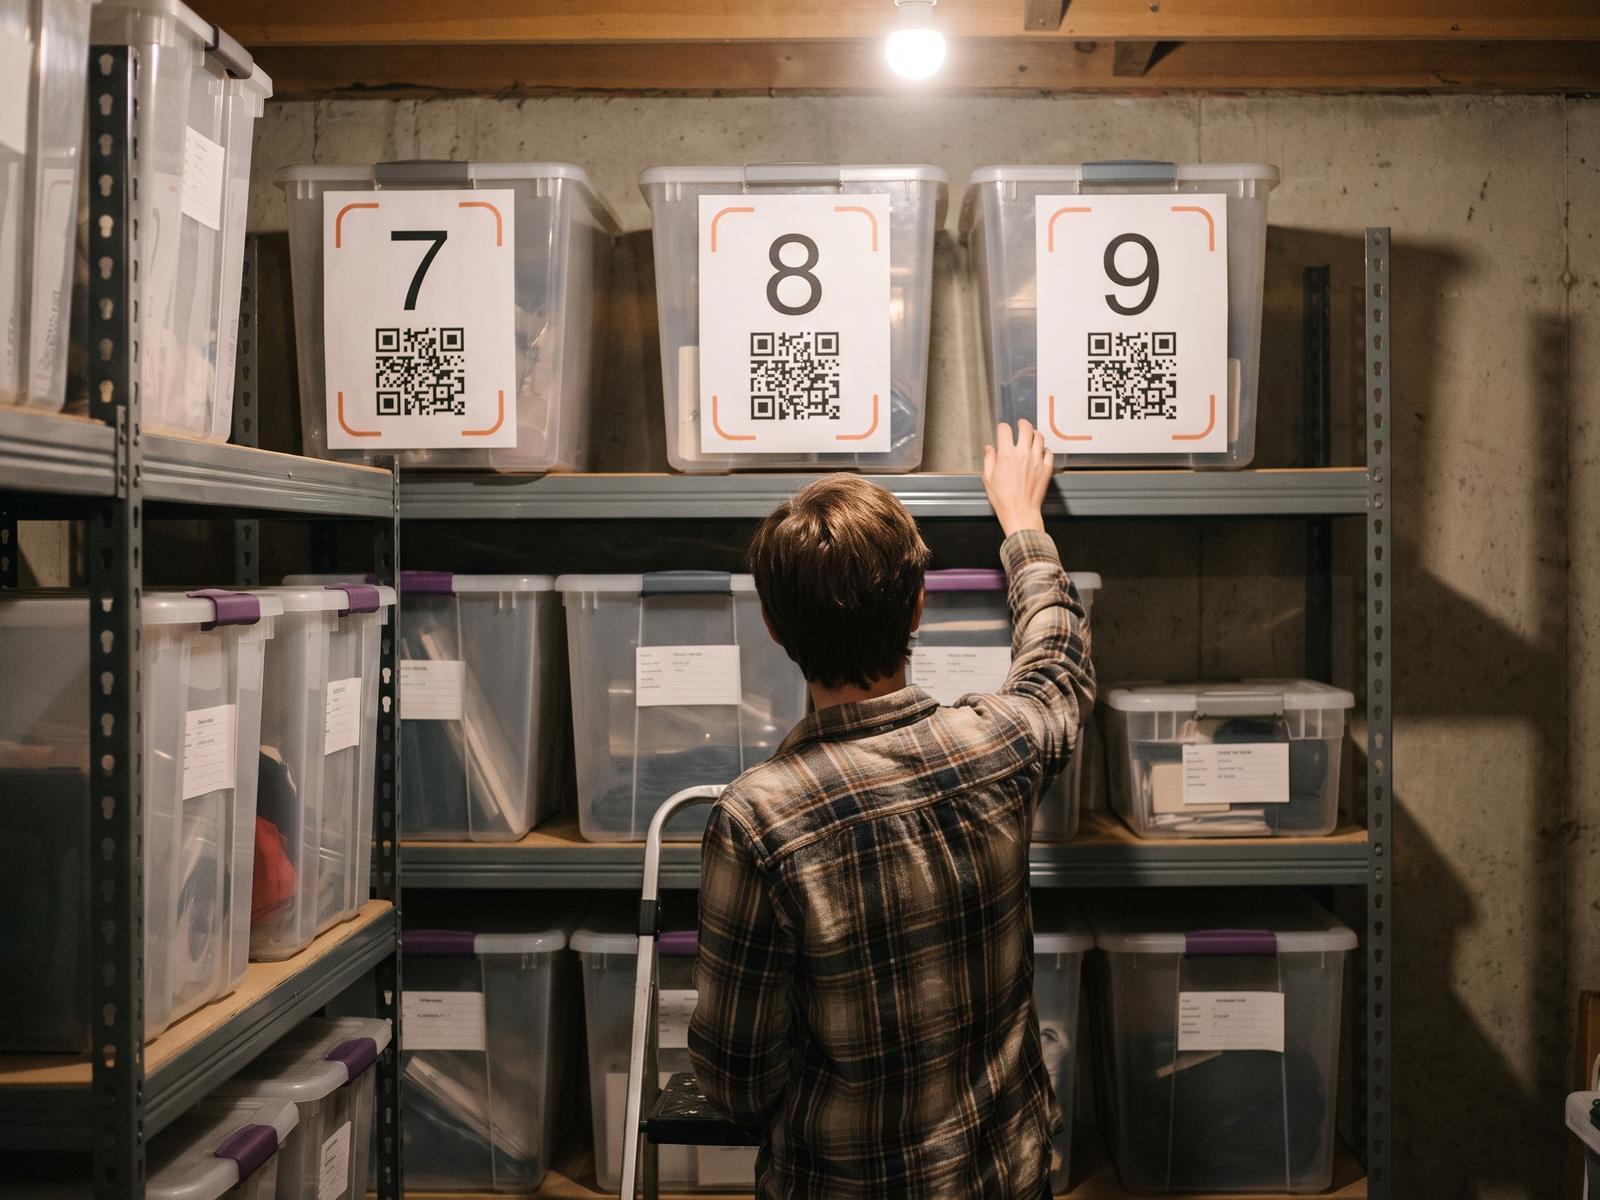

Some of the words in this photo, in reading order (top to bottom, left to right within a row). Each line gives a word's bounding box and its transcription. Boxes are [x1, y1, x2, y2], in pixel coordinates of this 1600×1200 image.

[391, 231, 448, 311] 7
[766, 233, 822, 316] 8
[1103, 232, 1160, 316] 9
